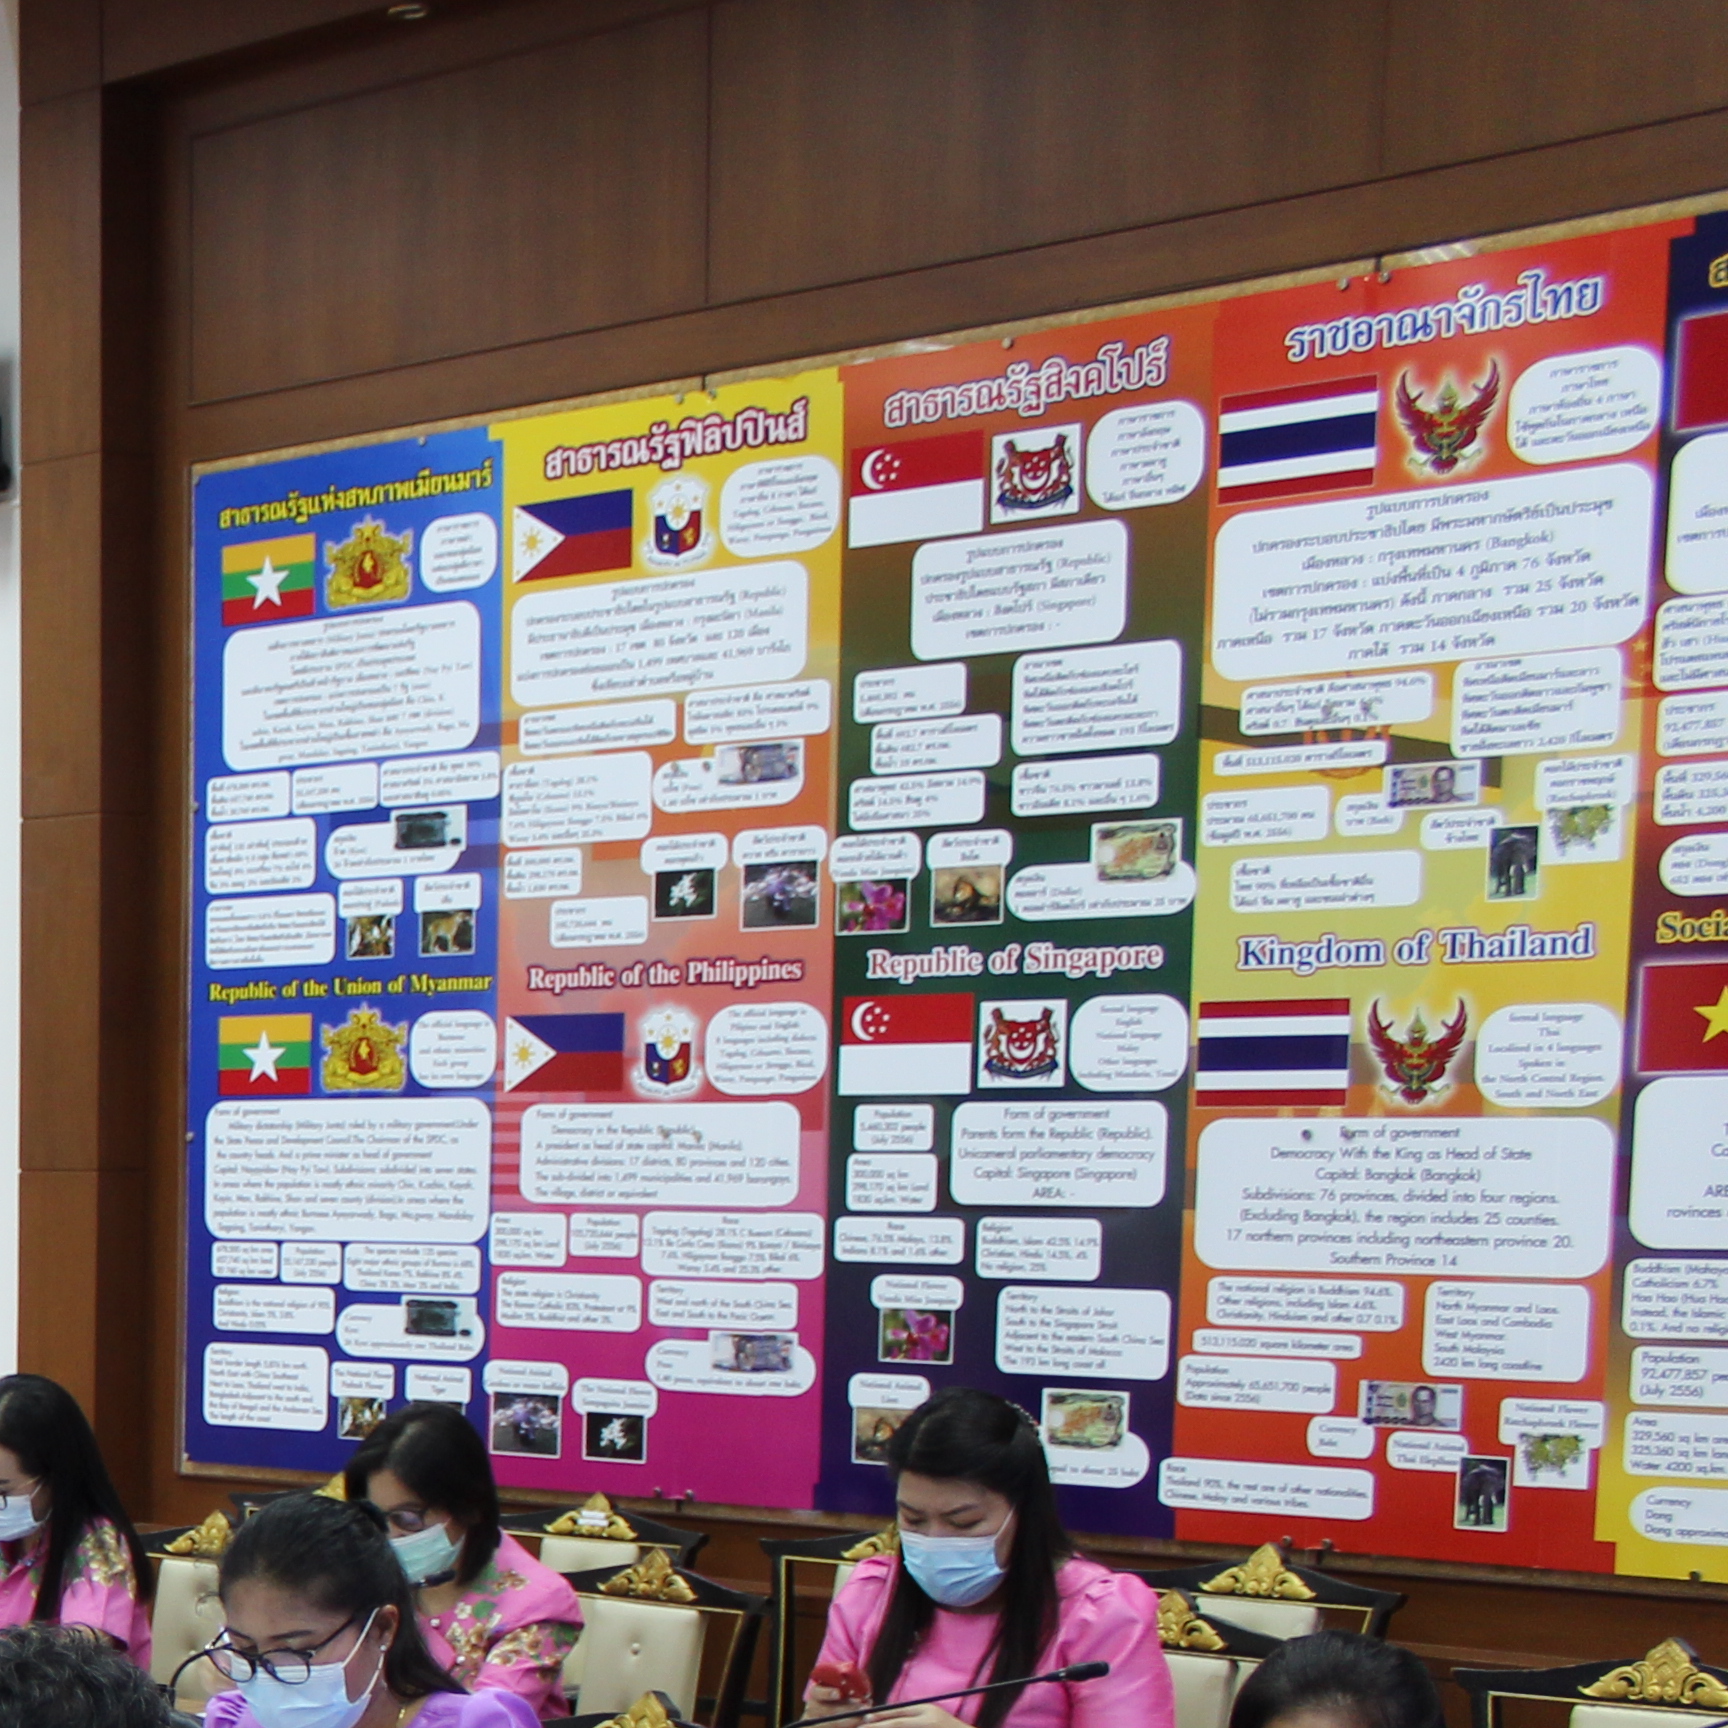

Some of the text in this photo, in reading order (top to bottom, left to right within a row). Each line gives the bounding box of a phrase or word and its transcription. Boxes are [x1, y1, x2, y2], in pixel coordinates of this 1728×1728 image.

[1284, 272, 1604, 363] ราชอาณาจักรไทย
[884, 336, 1170, 428] สาธารณรัฐสิงคโปร์
[544, 398, 808, 479] สาธารณรัฐฟิลิปปินส์
[219, 458, 493, 529] สาธารณรัฐแห่งสหภาพเมียนมาร์
[1236, 922, 1594, 974] Kingdom of Thailand
[527, 959, 803, 994] Republic of the Philippines
[866, 944, 1162, 984] Republic of Singapore
[209, 974, 493, 1005] Republic of the Union of Myanmar
[1373, 1123, 1386, 1138] of
[1389, 1127, 1461, 1142] government
[1270, 1145, 1532, 1164] Democracy With the King as Head of State
[1364, 1166, 1416, 1185] Bangkok
[1419, 1166, 1482, 1185] (Bangkok)
[1319, 1187, 1336, 1201] 76
[1402, 1187, 1449, 1203] divided
[1452, 1189, 1476, 1203] into
[1479, 1188, 1506, 1203] four
[1364, 1209, 1384, 1223] the
[1386, 1211, 1426, 1228] region
[1429, 1209, 1480, 1225] includes
[1483, 1211, 1502, 1225] 25
[1227, 1228, 1242, 1241] 17
[1245, 1228, 1294, 1242] northern
[1297, 1231, 1353, 1246] provinces
[1356, 1230, 1411, 1249] including
[1414, 1231, 1489, 1246] northeastern
[1493, 1234, 1548, 1250] province
[1329, 1250, 1458, 1267] Southern Province 14
